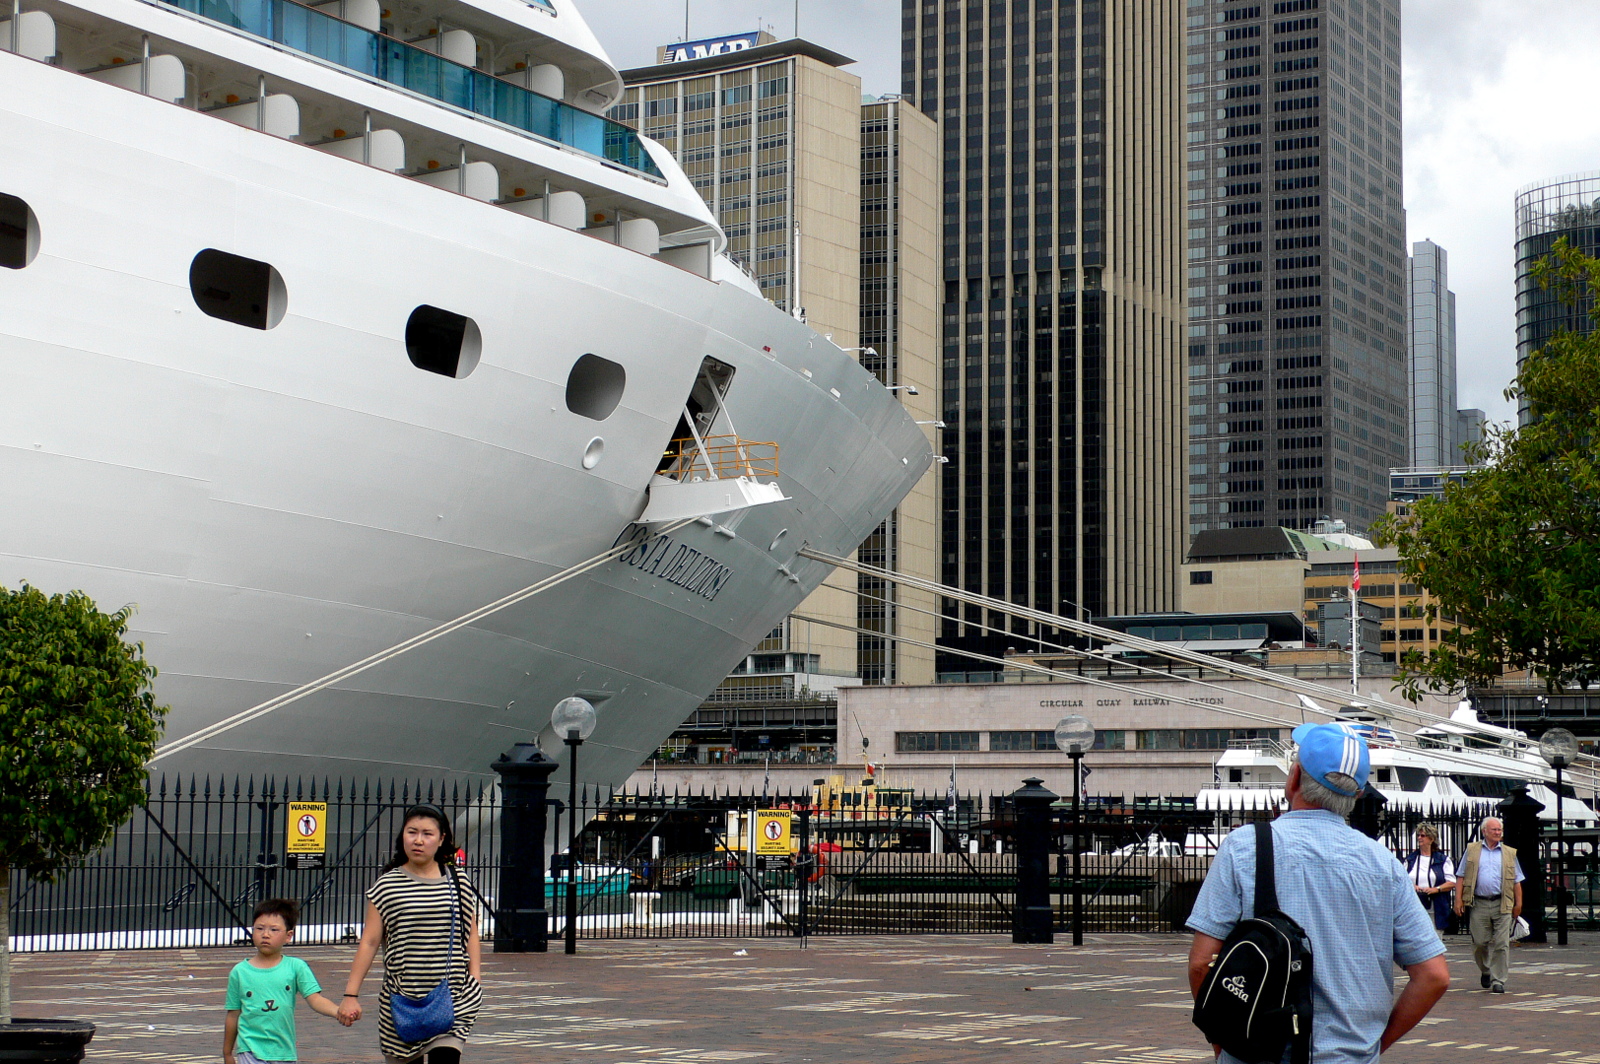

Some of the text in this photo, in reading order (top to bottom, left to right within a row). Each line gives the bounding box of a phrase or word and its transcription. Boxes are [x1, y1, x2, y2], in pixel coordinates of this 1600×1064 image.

[674, 39, 752, 62] AMP
[609, 522, 735, 602] COSTA DELIZIOSA
[1039, 697, 1225, 708] CIRCULAR QUAY RAILWAY TATION
[290, 803, 326, 812] WARNING
[1221, 977, 1249, 1003] Costa
